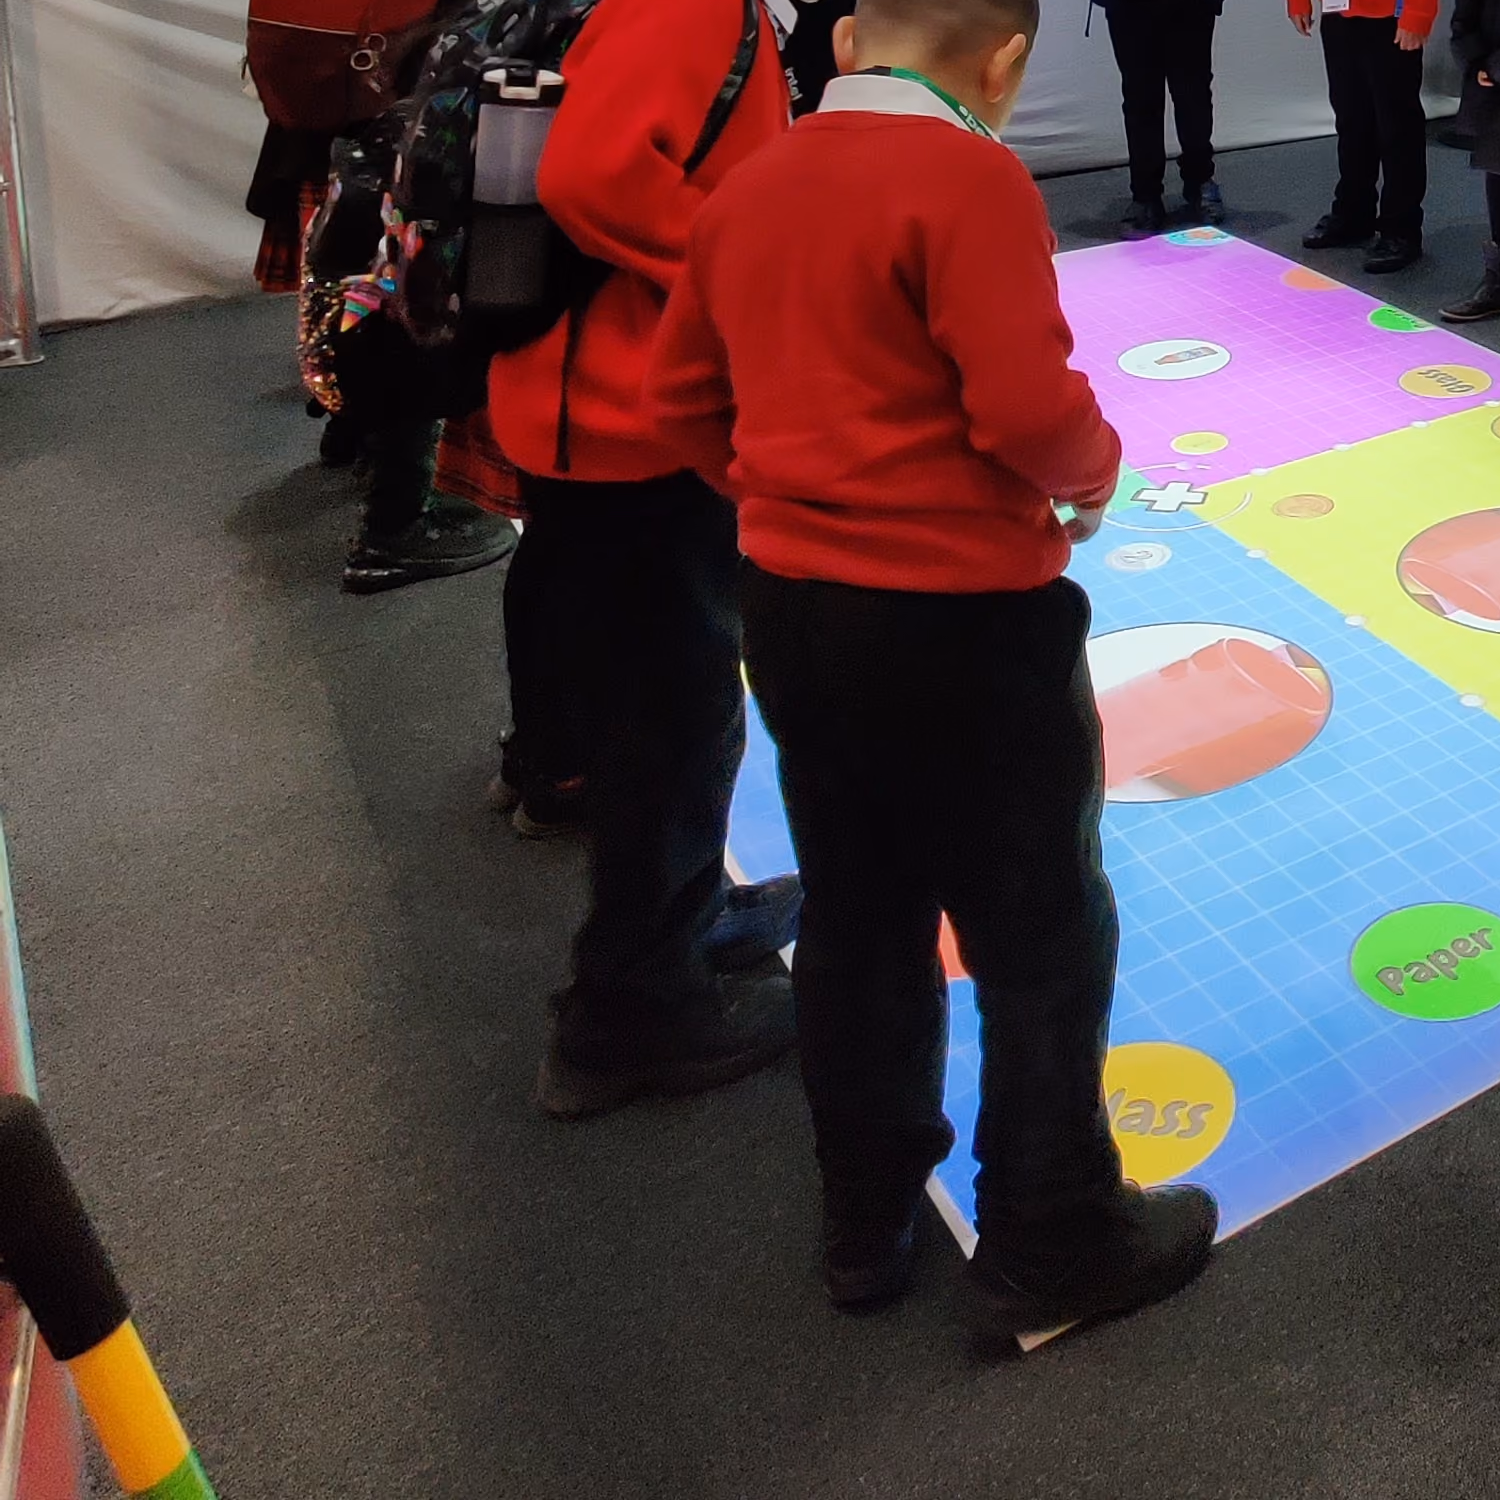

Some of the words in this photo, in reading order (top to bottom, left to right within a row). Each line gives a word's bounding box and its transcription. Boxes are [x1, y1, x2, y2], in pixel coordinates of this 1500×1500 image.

[1417, 368, 1476, 394] Glass
[1375, 924, 1494, 997] Paper
[1107, 1088, 1215, 1140] lass
